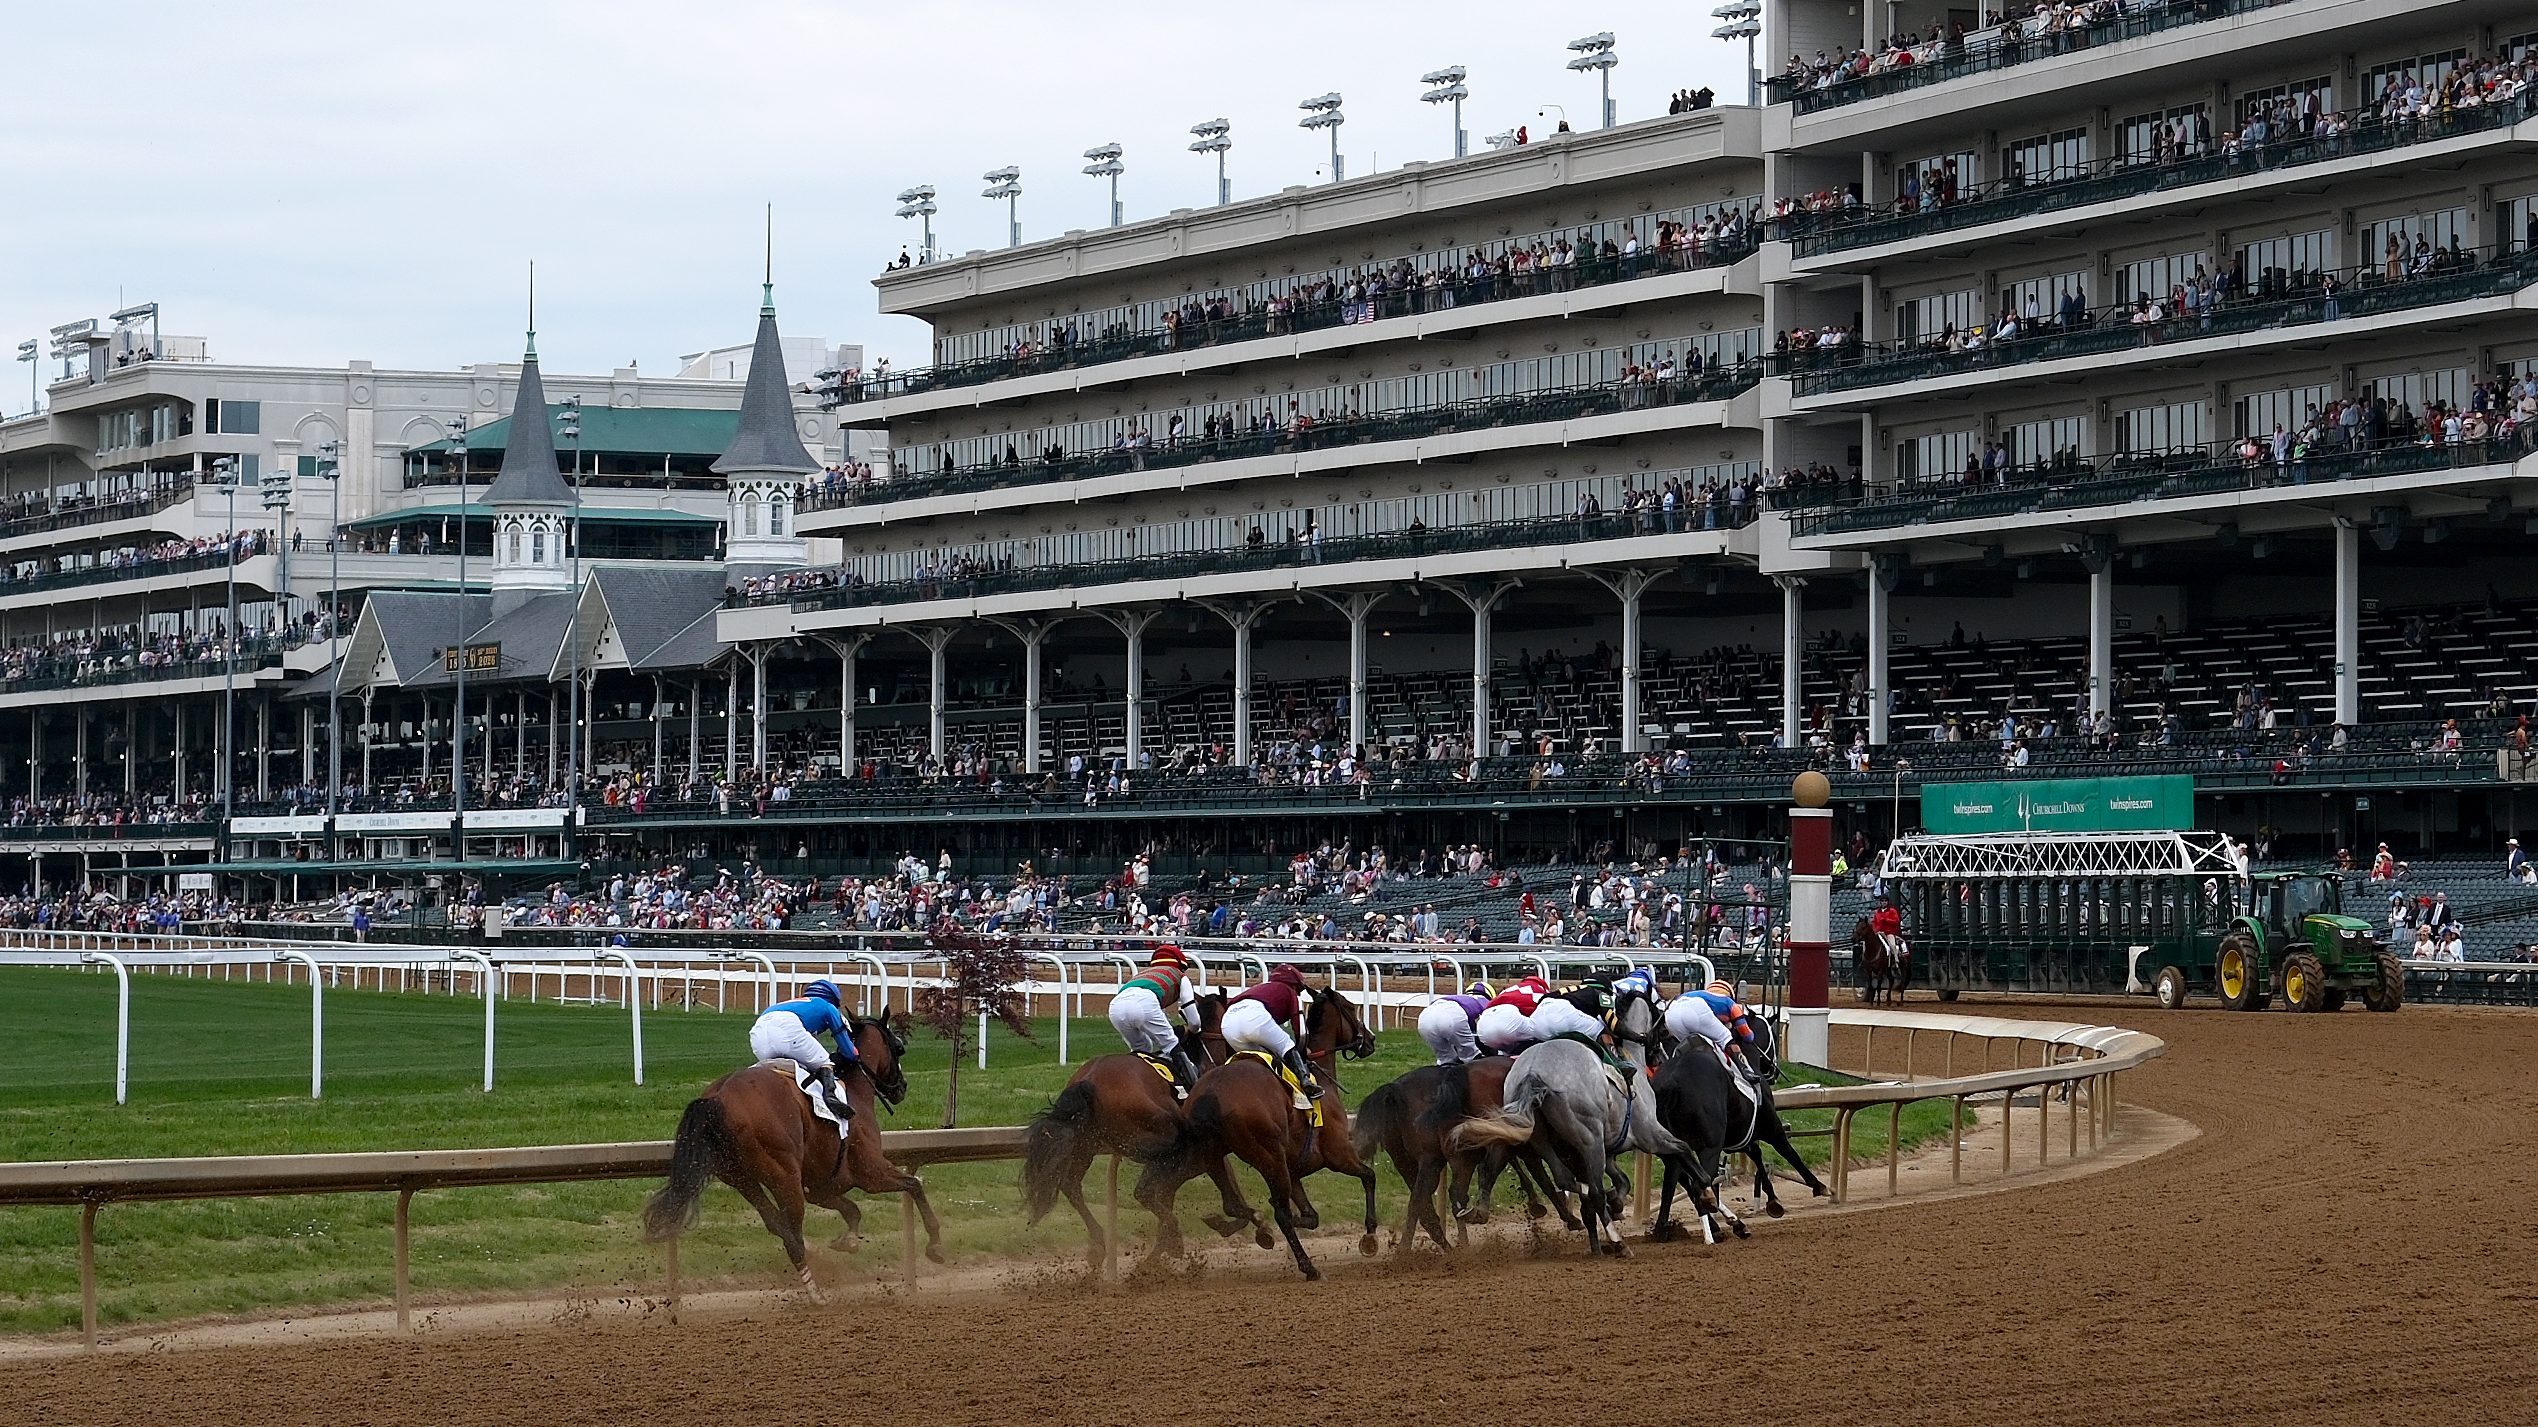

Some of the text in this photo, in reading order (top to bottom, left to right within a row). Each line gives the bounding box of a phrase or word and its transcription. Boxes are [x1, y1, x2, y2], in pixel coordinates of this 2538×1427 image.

[1953, 800, 1993, 816] twinspires.com
[2032, 801, 2085, 815] CHURCHILL DOWNS
[2110, 794, 2153, 811] twinspires.com
